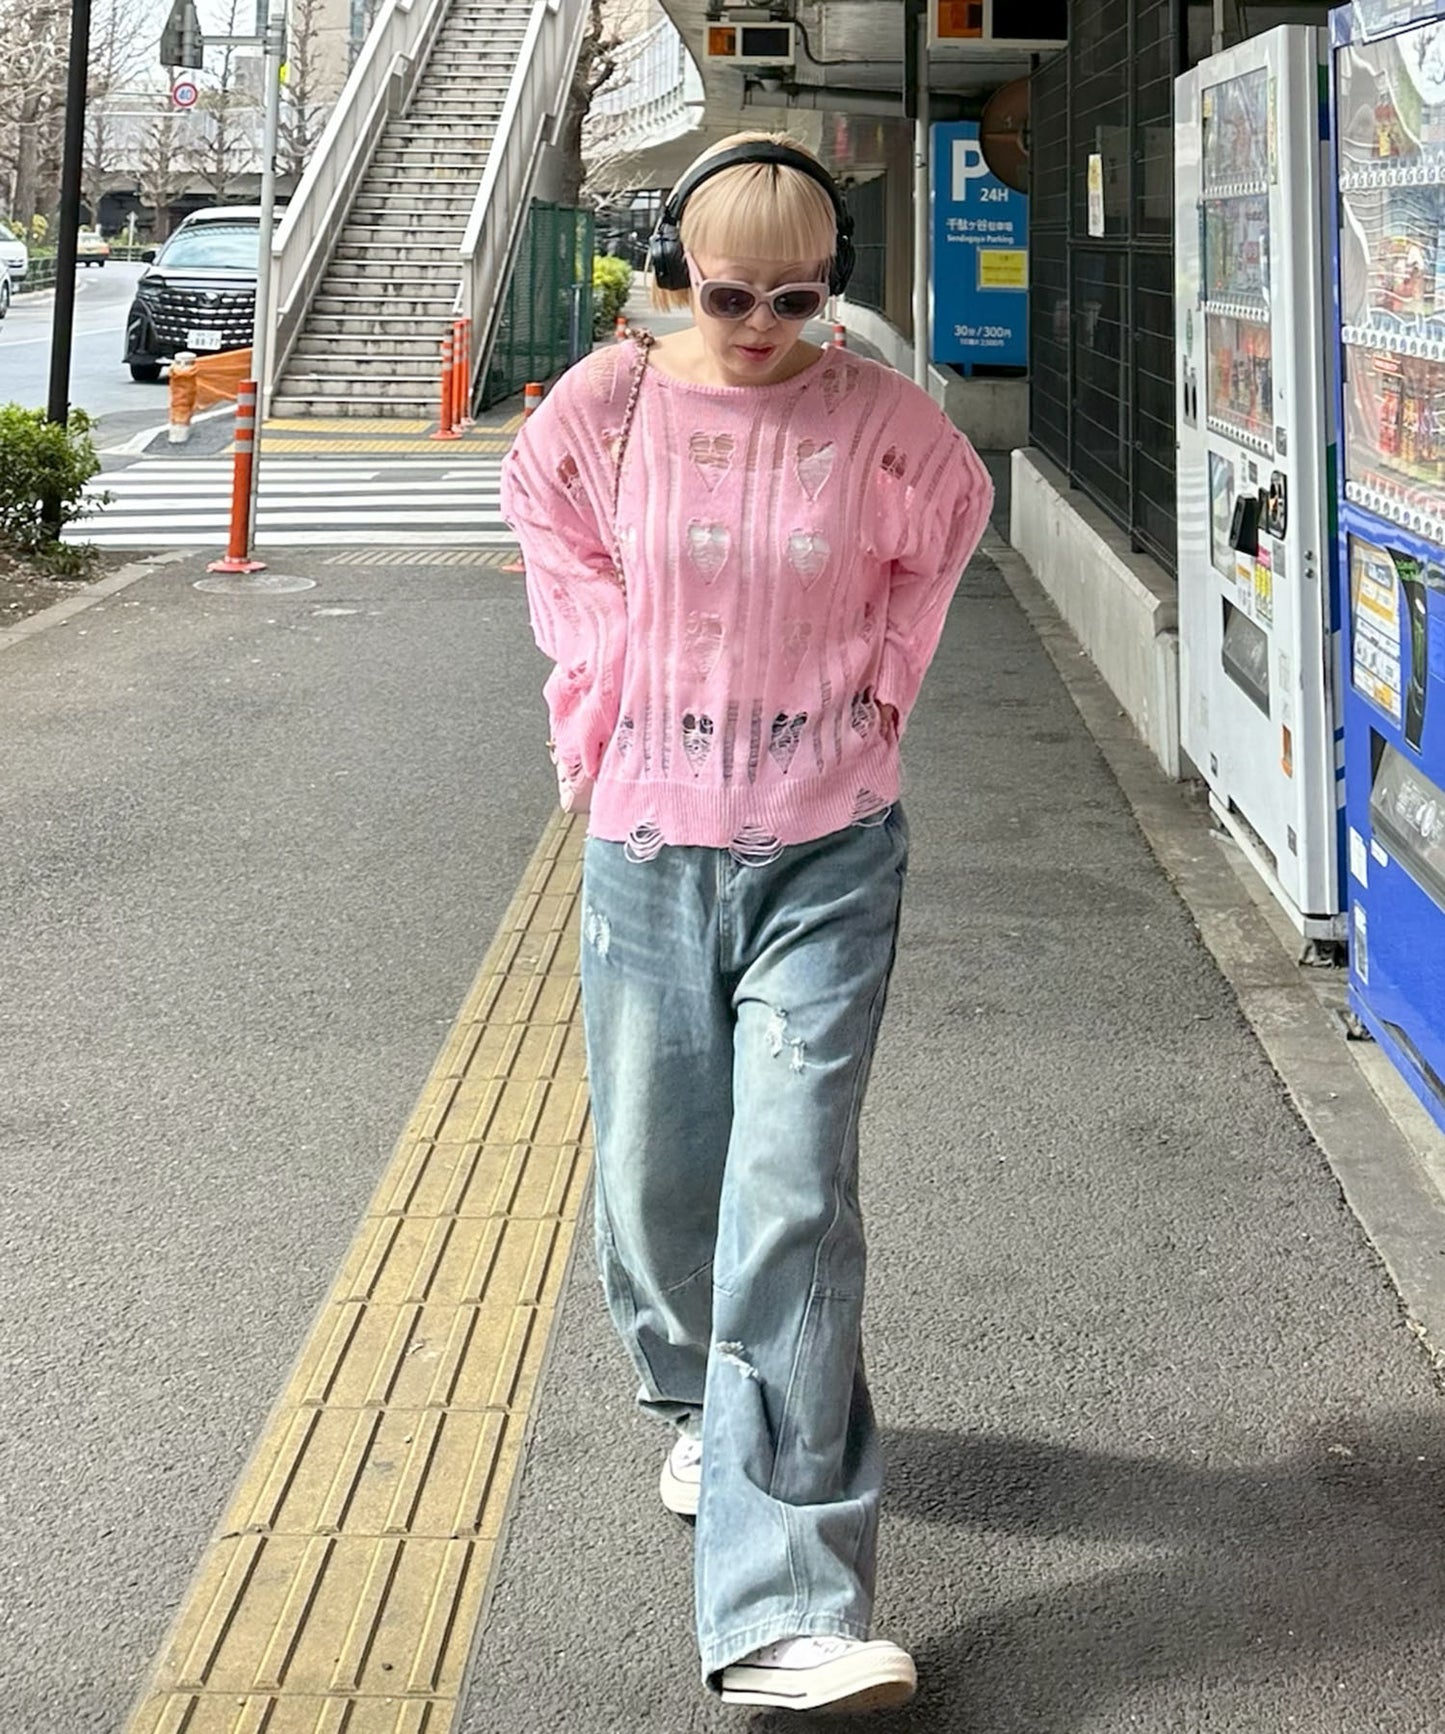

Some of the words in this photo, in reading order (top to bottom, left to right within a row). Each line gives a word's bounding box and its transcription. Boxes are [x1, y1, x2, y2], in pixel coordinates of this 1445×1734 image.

[179, 89, 192, 100] 40
[952, 139, 991, 201] P
[980, 187, 1009, 202] 24H
[986, 234, 1015, 245] Parking
